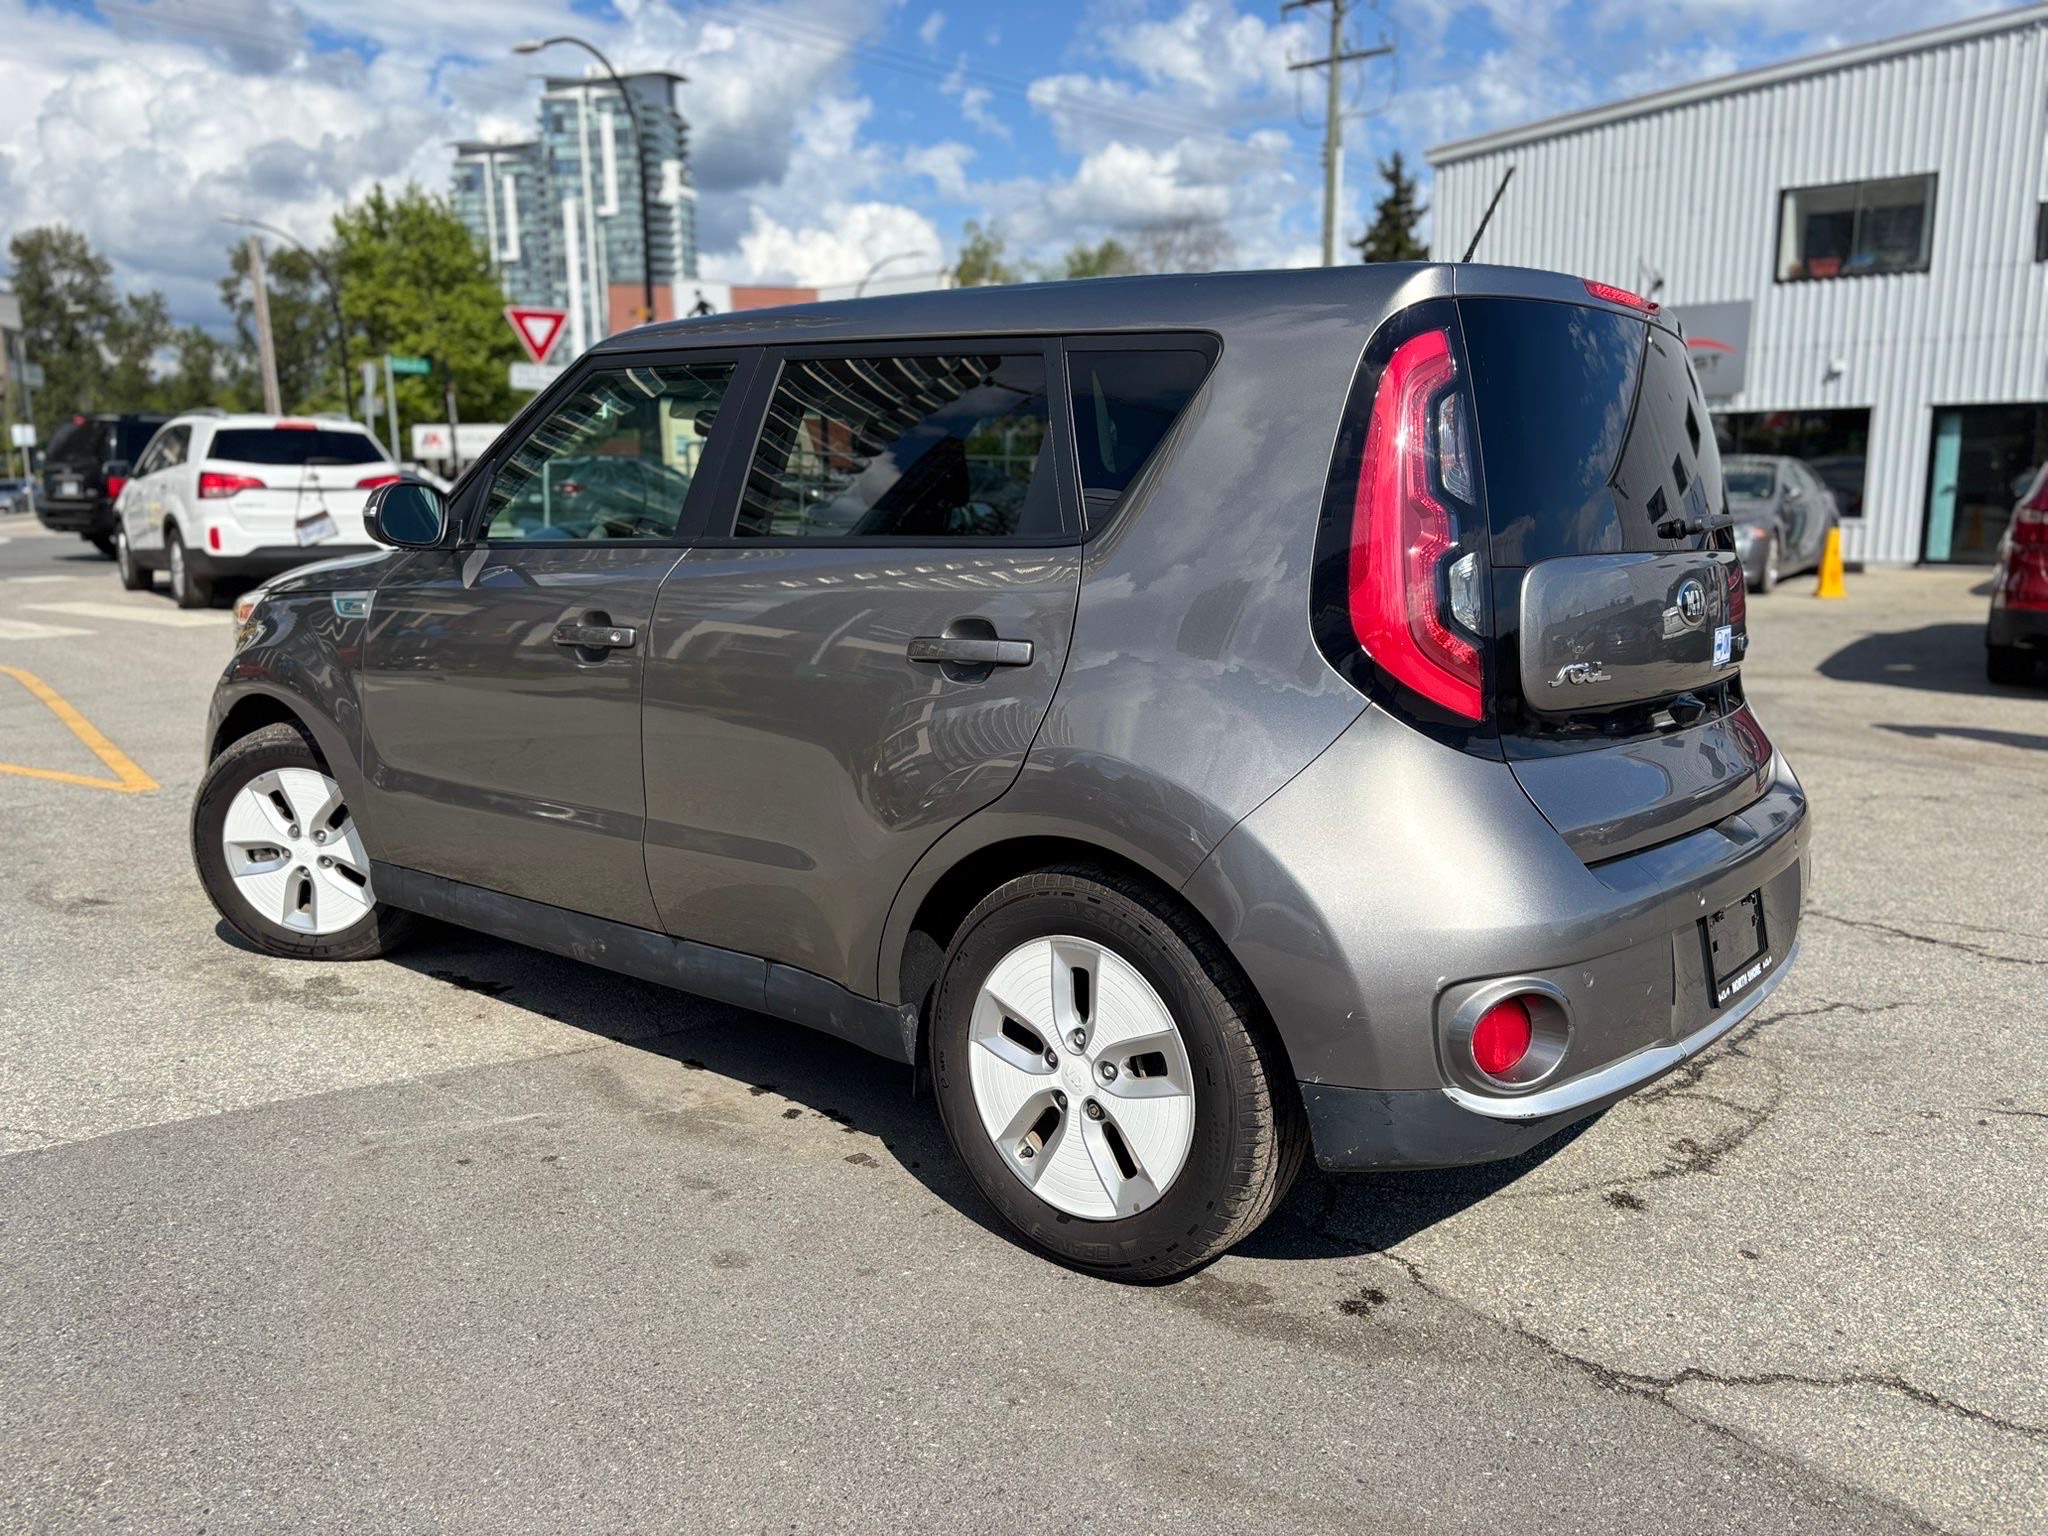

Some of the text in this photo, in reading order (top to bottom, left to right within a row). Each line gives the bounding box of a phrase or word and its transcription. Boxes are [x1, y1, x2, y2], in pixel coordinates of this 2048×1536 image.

[1547, 661, 1612, 687] SOUL
[1731, 973, 1748, 994] NORTH
[1746, 962, 1762, 982] SHORE
